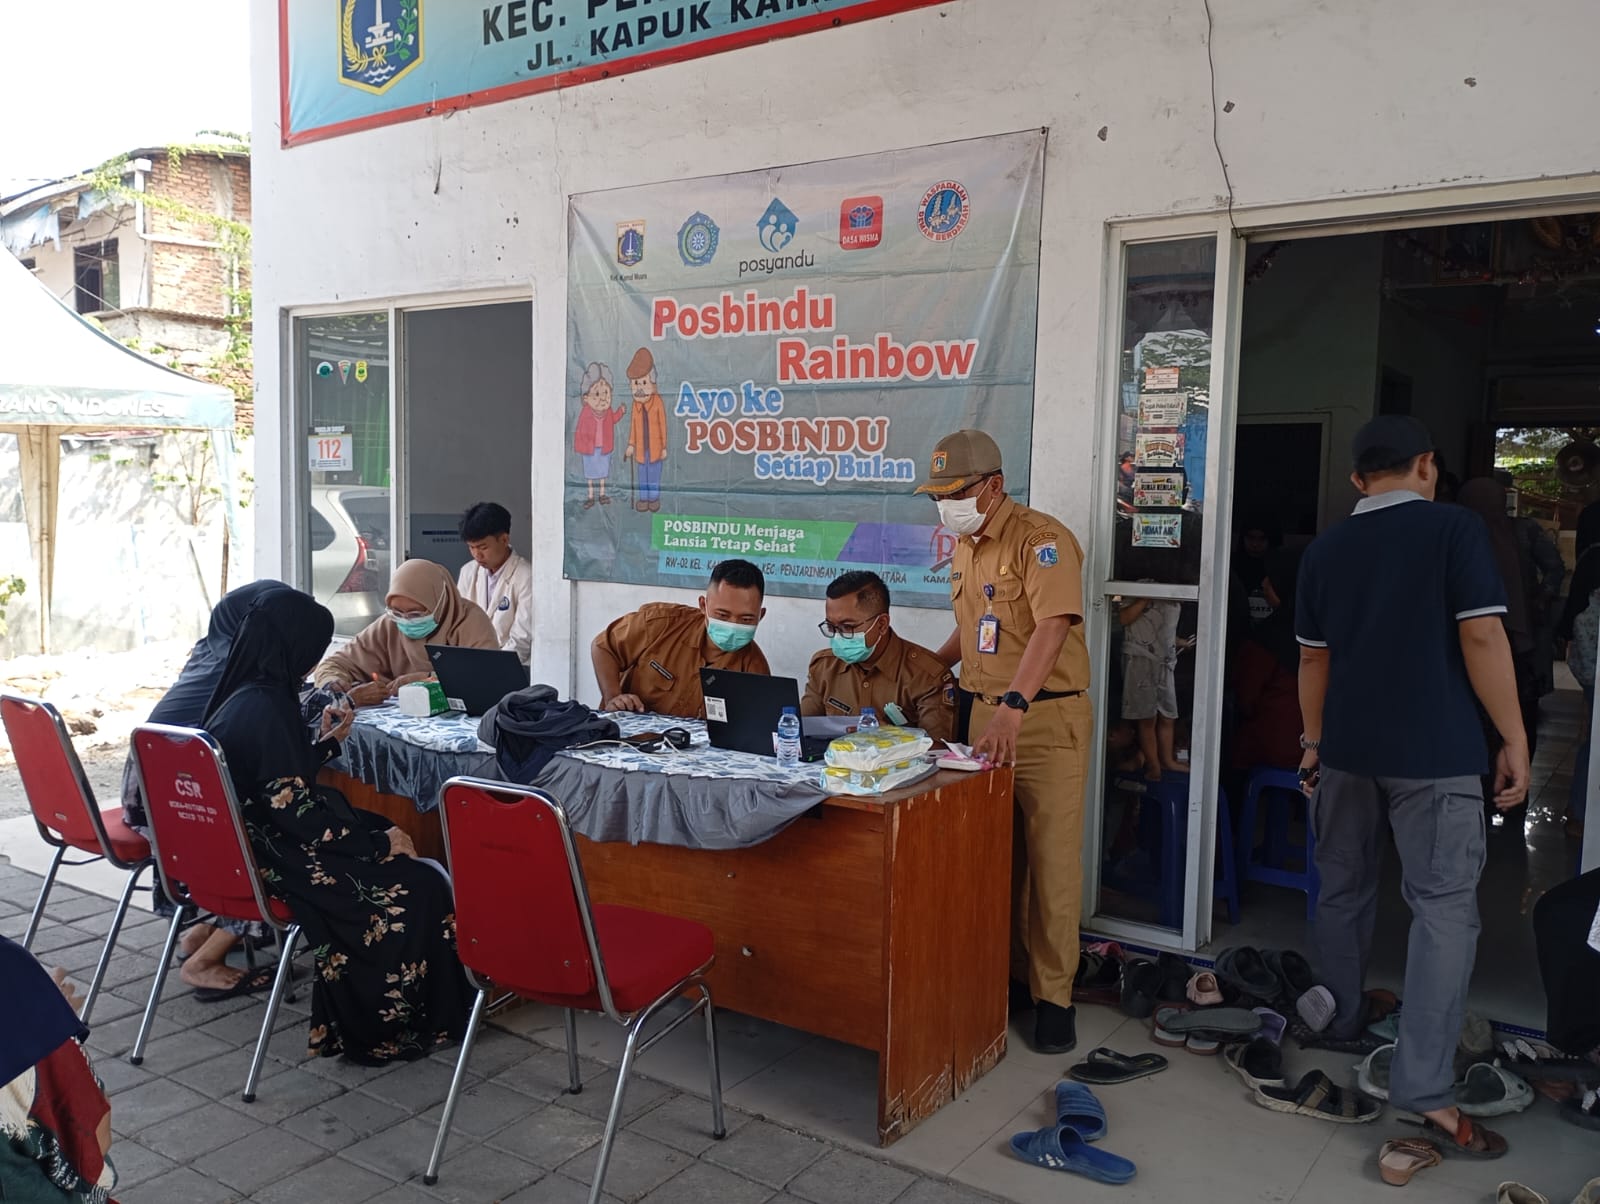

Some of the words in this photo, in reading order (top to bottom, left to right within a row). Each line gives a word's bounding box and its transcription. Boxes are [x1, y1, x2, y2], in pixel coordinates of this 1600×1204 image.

[483, 0, 566, 46] KEC.
[527, 40, 573, 71] JL.
[591, 1, 712, 56] KAPUK
[921, 181, 967, 207] WASPADALAH
[935, 205, 969, 241] BERDARAH
[842, 235, 858, 245] DASA
[858, 233, 879, 244] WISMA
[738, 249, 815, 277] posyandu
[652, 289, 833, 337] Posbindu
[779, 336, 976, 381] Rainbow
[676, 383, 735, 420] Ayo
[742, 382, 783, 414] ke
[318, 439, 342, 459] 112
[686, 419, 888, 453] POSBINDU
[755, 454, 832, 482] Setiap
[837, 454, 914, 479] Bulan
[663, 534, 707, 548] Lansia
[711, 536, 751, 552] Tetap
[754, 539, 797, 554] Sehat
[664, 520, 741, 535] POSBINDU
[744, 523, 804, 541] Menjaga
[780, 564, 836, 577] PENJARINGAN
[175, 779, 203, 799] CSR
